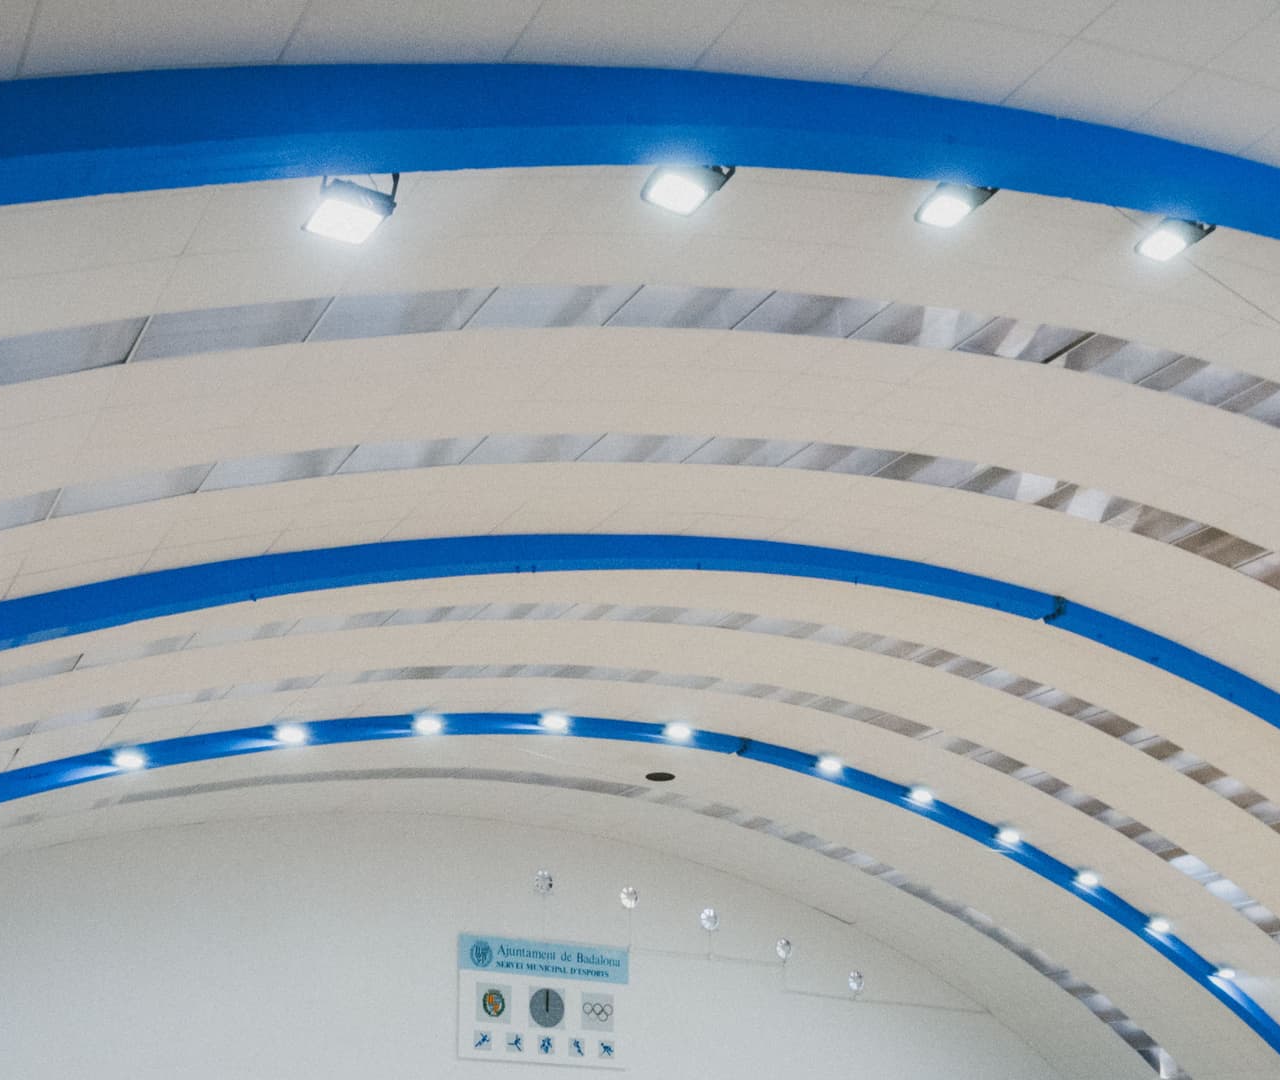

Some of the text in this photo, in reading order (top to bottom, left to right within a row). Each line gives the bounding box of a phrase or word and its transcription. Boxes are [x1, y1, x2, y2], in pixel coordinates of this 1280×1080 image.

[497, 944, 621, 968] Ajuntament de Badalona
[496, 960, 524, 970] SERVEI
[525, 963, 567, 975] MUNICIPAL
